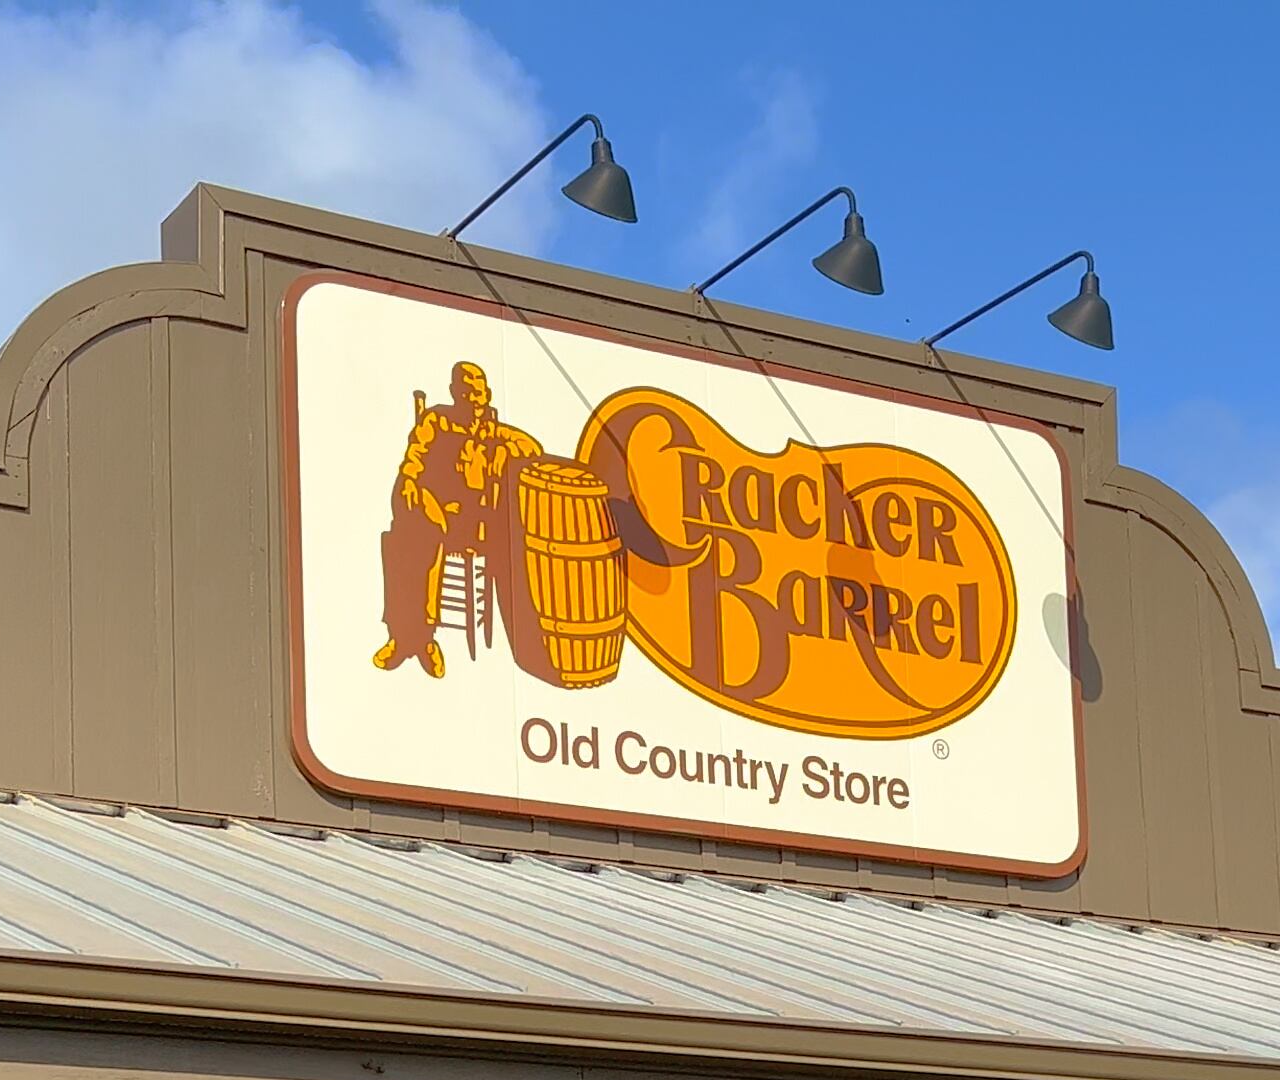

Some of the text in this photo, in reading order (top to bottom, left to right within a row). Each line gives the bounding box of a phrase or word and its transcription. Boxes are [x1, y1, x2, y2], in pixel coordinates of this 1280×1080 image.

[520, 717, 910, 810] Old Country Store
